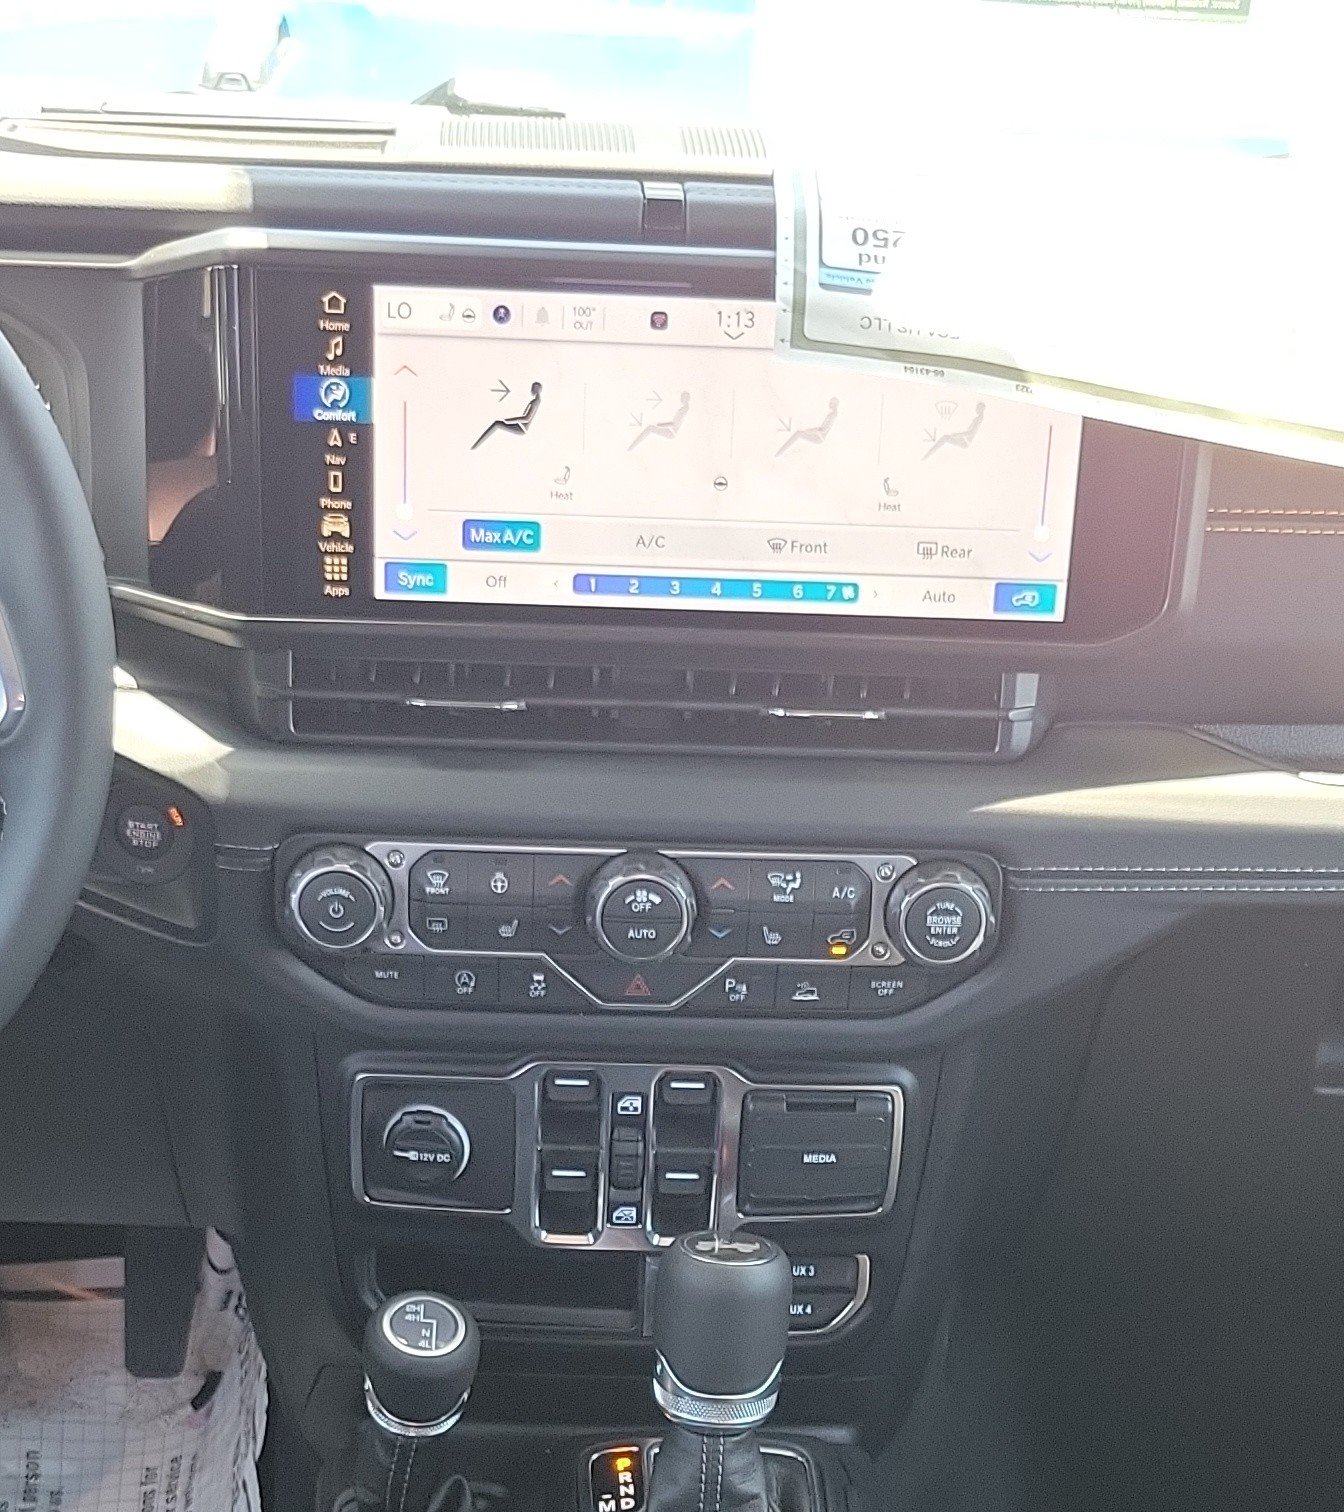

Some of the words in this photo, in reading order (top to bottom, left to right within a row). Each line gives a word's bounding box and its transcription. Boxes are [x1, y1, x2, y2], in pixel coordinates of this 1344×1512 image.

[387, 302, 412, 320] LO
[717, 310, 755, 329] 1:13
[319, 320, 350, 332] Home
[319, 364, 350, 376] Media
[313, 409, 356, 422] Comfort
[324, 455, 347, 466] Nav
[320, 498, 352, 511] Phone
[878, 501, 901, 513] Heat
[470, 529, 502, 543] Max
[505, 529, 533, 545] A/C
[635, 534, 666, 549] A/C
[318, 542, 354, 555] Vehicle
[791, 540, 827, 556] Front
[940, 544, 973, 560] Rear
[397, 571, 434, 588] Sync
[485, 575, 507, 588] Off
[323, 585, 350, 598] Apps
[589, 578, 597, 592] 1
[628, 579, 639, 594] 2
[669, 580, 680, 595] 3
[710, 582, 722, 596] 4
[752, 583, 762, 598] 5
[792, 585, 804, 599] 6
[826, 585, 836, 599] 7
[922, 589, 956, 604] Auto
[321, 887, 350, 898] VOLUME
[425, 887, 449, 895] FRONT
[832, 887, 855, 898] A/C
[773, 894, 794, 903] MODE
[631, 903, 652, 912] OFF
[935, 902, 955, 911] TUNE
[926, 915, 962, 925] BROWSE
[628, 929, 656, 939] AUTO
[931, 926, 958, 934] ENTER
[928, 938, 958, 948] SCROLL
[375, 971, 399, 979] MUTE
[870, 981, 903, 989] SCREEN
[529, 990, 545, 998] OFF
[729, 993, 745, 1002] OFF
[420, 1153, 434, 1161] 12V
[437, 1154, 450, 1162] DC
[804, 1153, 837, 1164] MEDIA
[792, 1266, 806, 1276] UX
[809, 1265, 815, 1276] 3
[789, 1305, 803, 1315] UX
[805, 1305, 812, 1314] 4
[422, 1328, 430, 1337] N
[418, 1340, 431, 1348] 4L
[616, 1457, 631, 1470] P
[618, 1472, 633, 1483] R
[619, 1484, 635, 1496] N
[599, 1500, 616, 1512] M
[620, 1498, 636, 1510] D
